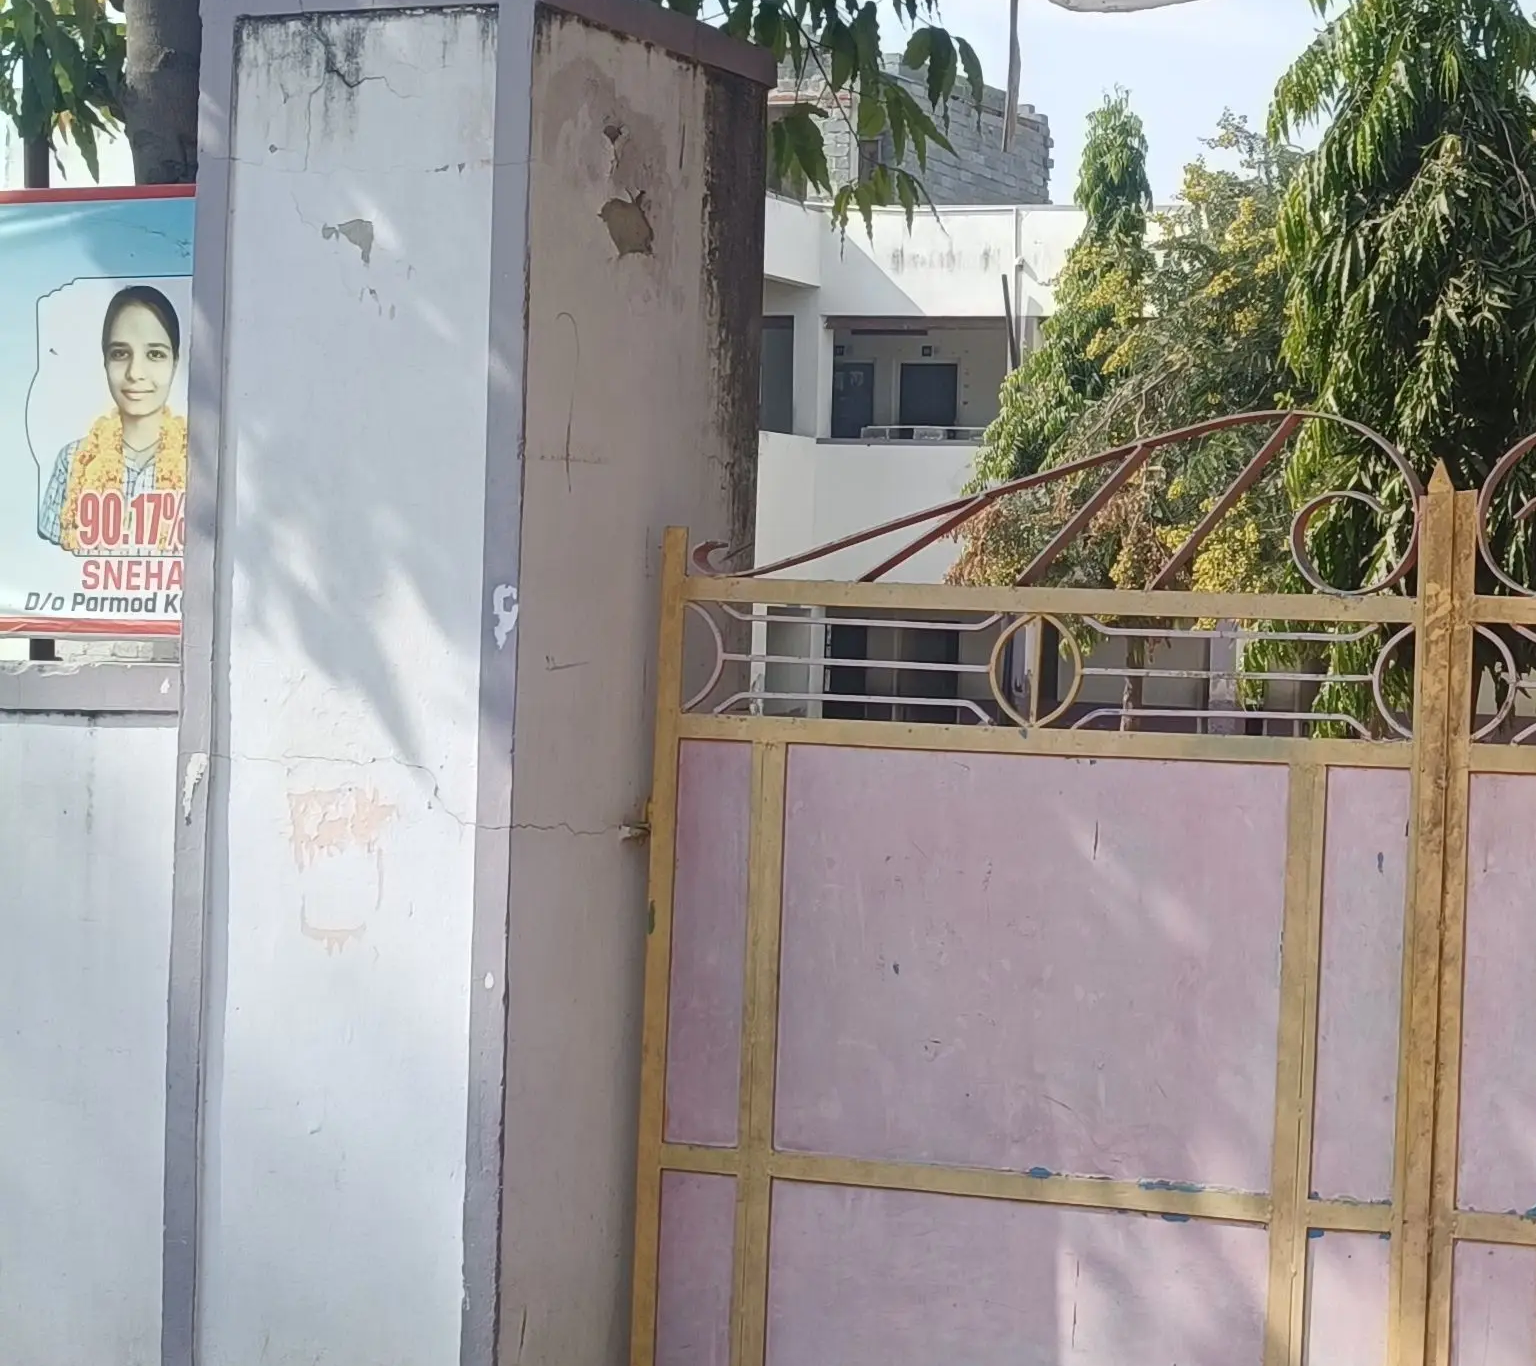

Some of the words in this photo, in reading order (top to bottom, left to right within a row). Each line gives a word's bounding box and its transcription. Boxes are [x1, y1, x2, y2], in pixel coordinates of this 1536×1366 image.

[81, 559, 184, 591] SNEHA
[24, 592, 65, 611] D/o
[71, 592, 158, 614] Parmod
[164, 593, 183, 614] K
